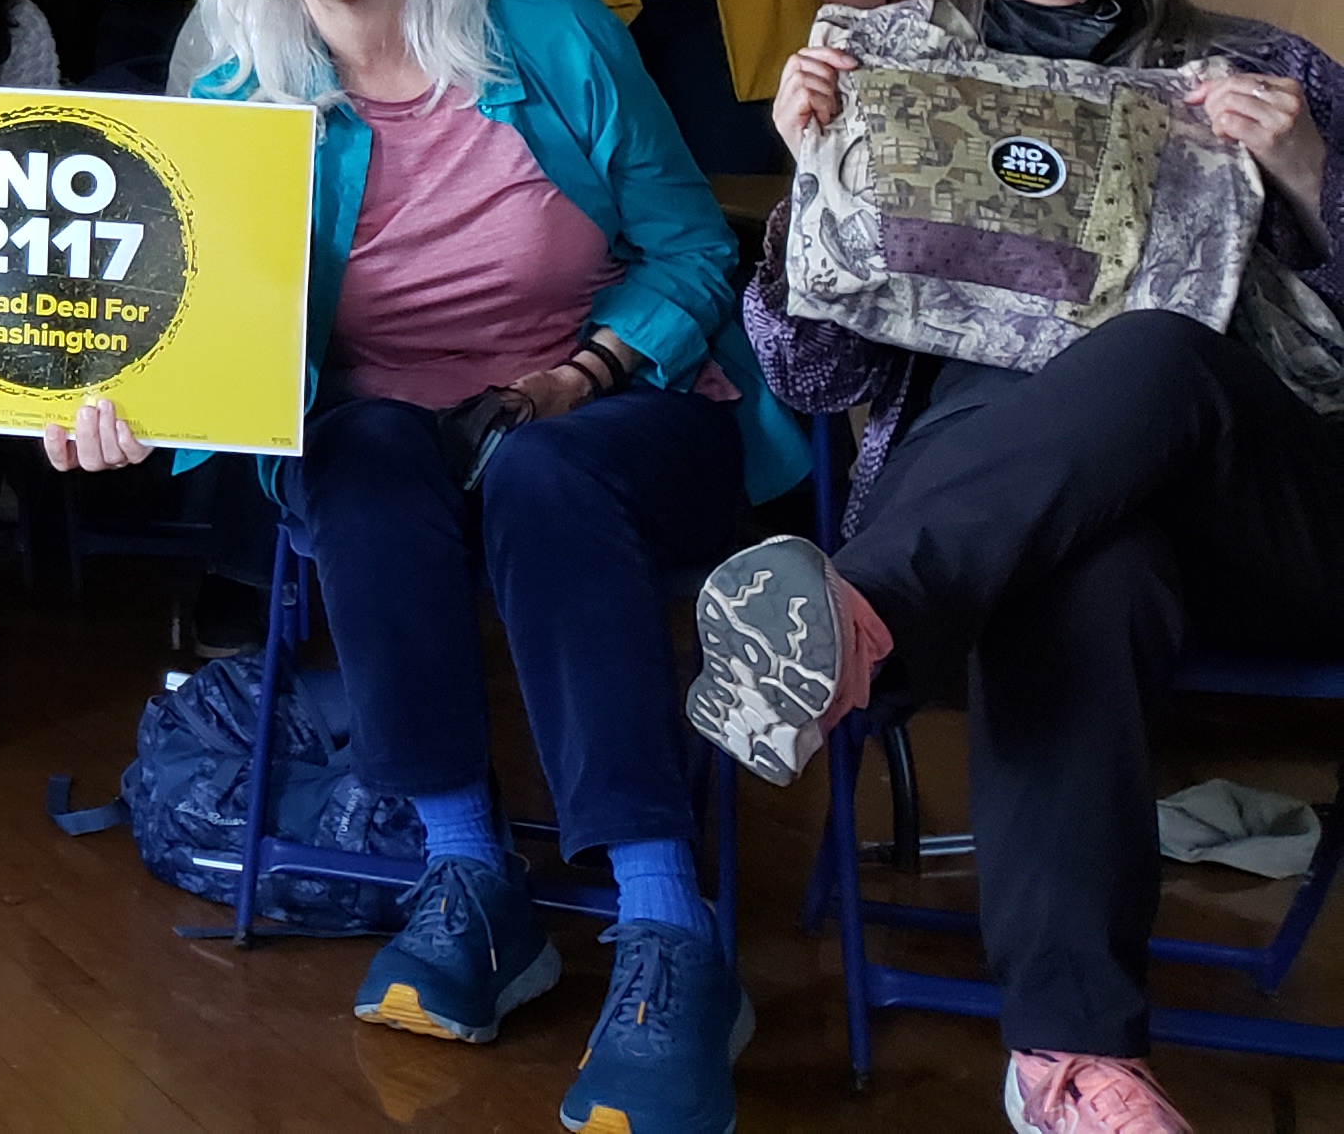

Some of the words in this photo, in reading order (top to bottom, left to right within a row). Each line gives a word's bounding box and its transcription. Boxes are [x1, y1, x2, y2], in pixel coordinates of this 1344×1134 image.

[1010, 145, 1043, 162] NO
[1002, 156, 1050, 176] 2117
[35, 293, 98, 319] Deal
[104, 298, 150, 322] For
